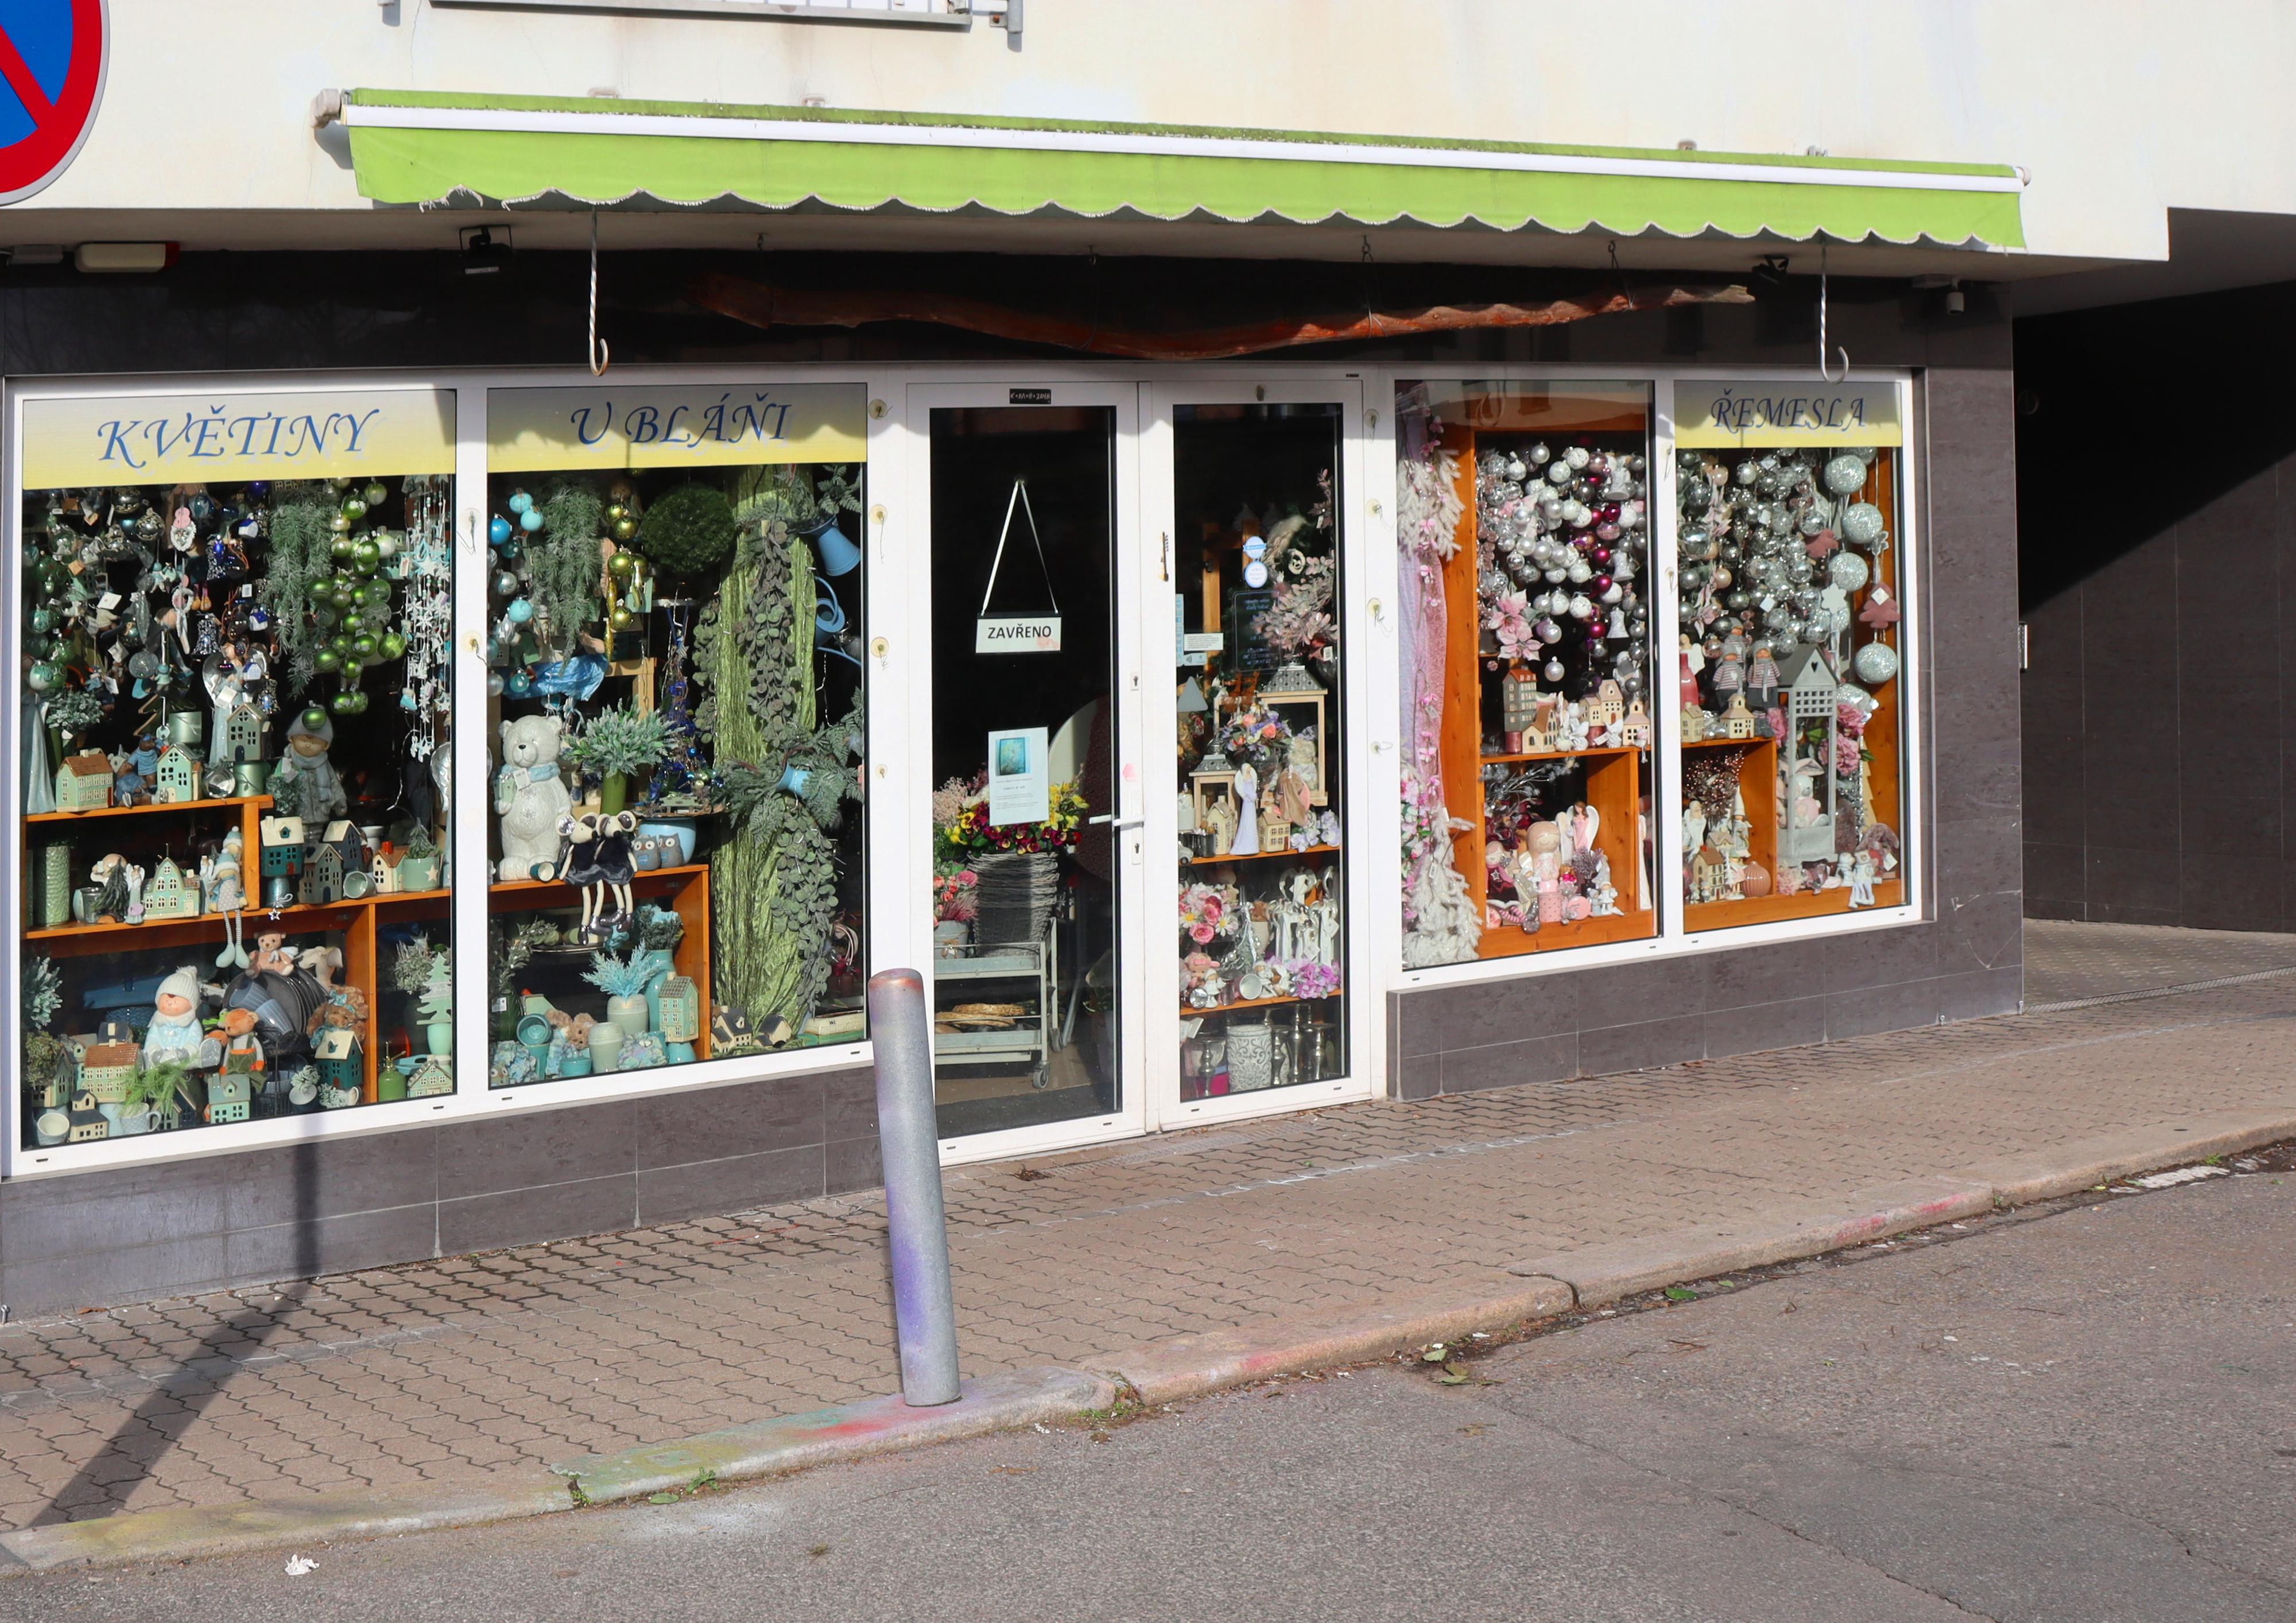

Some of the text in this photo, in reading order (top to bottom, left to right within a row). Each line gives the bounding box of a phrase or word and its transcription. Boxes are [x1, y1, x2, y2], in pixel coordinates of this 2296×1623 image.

[98, 404, 379, 468] KVĚTINY
[571, 392, 792, 448] U BLÁŇI
[1711, 388, 1865, 434] ŘEMESLA
[987, 623, 1052, 639] ZAVŘENO
